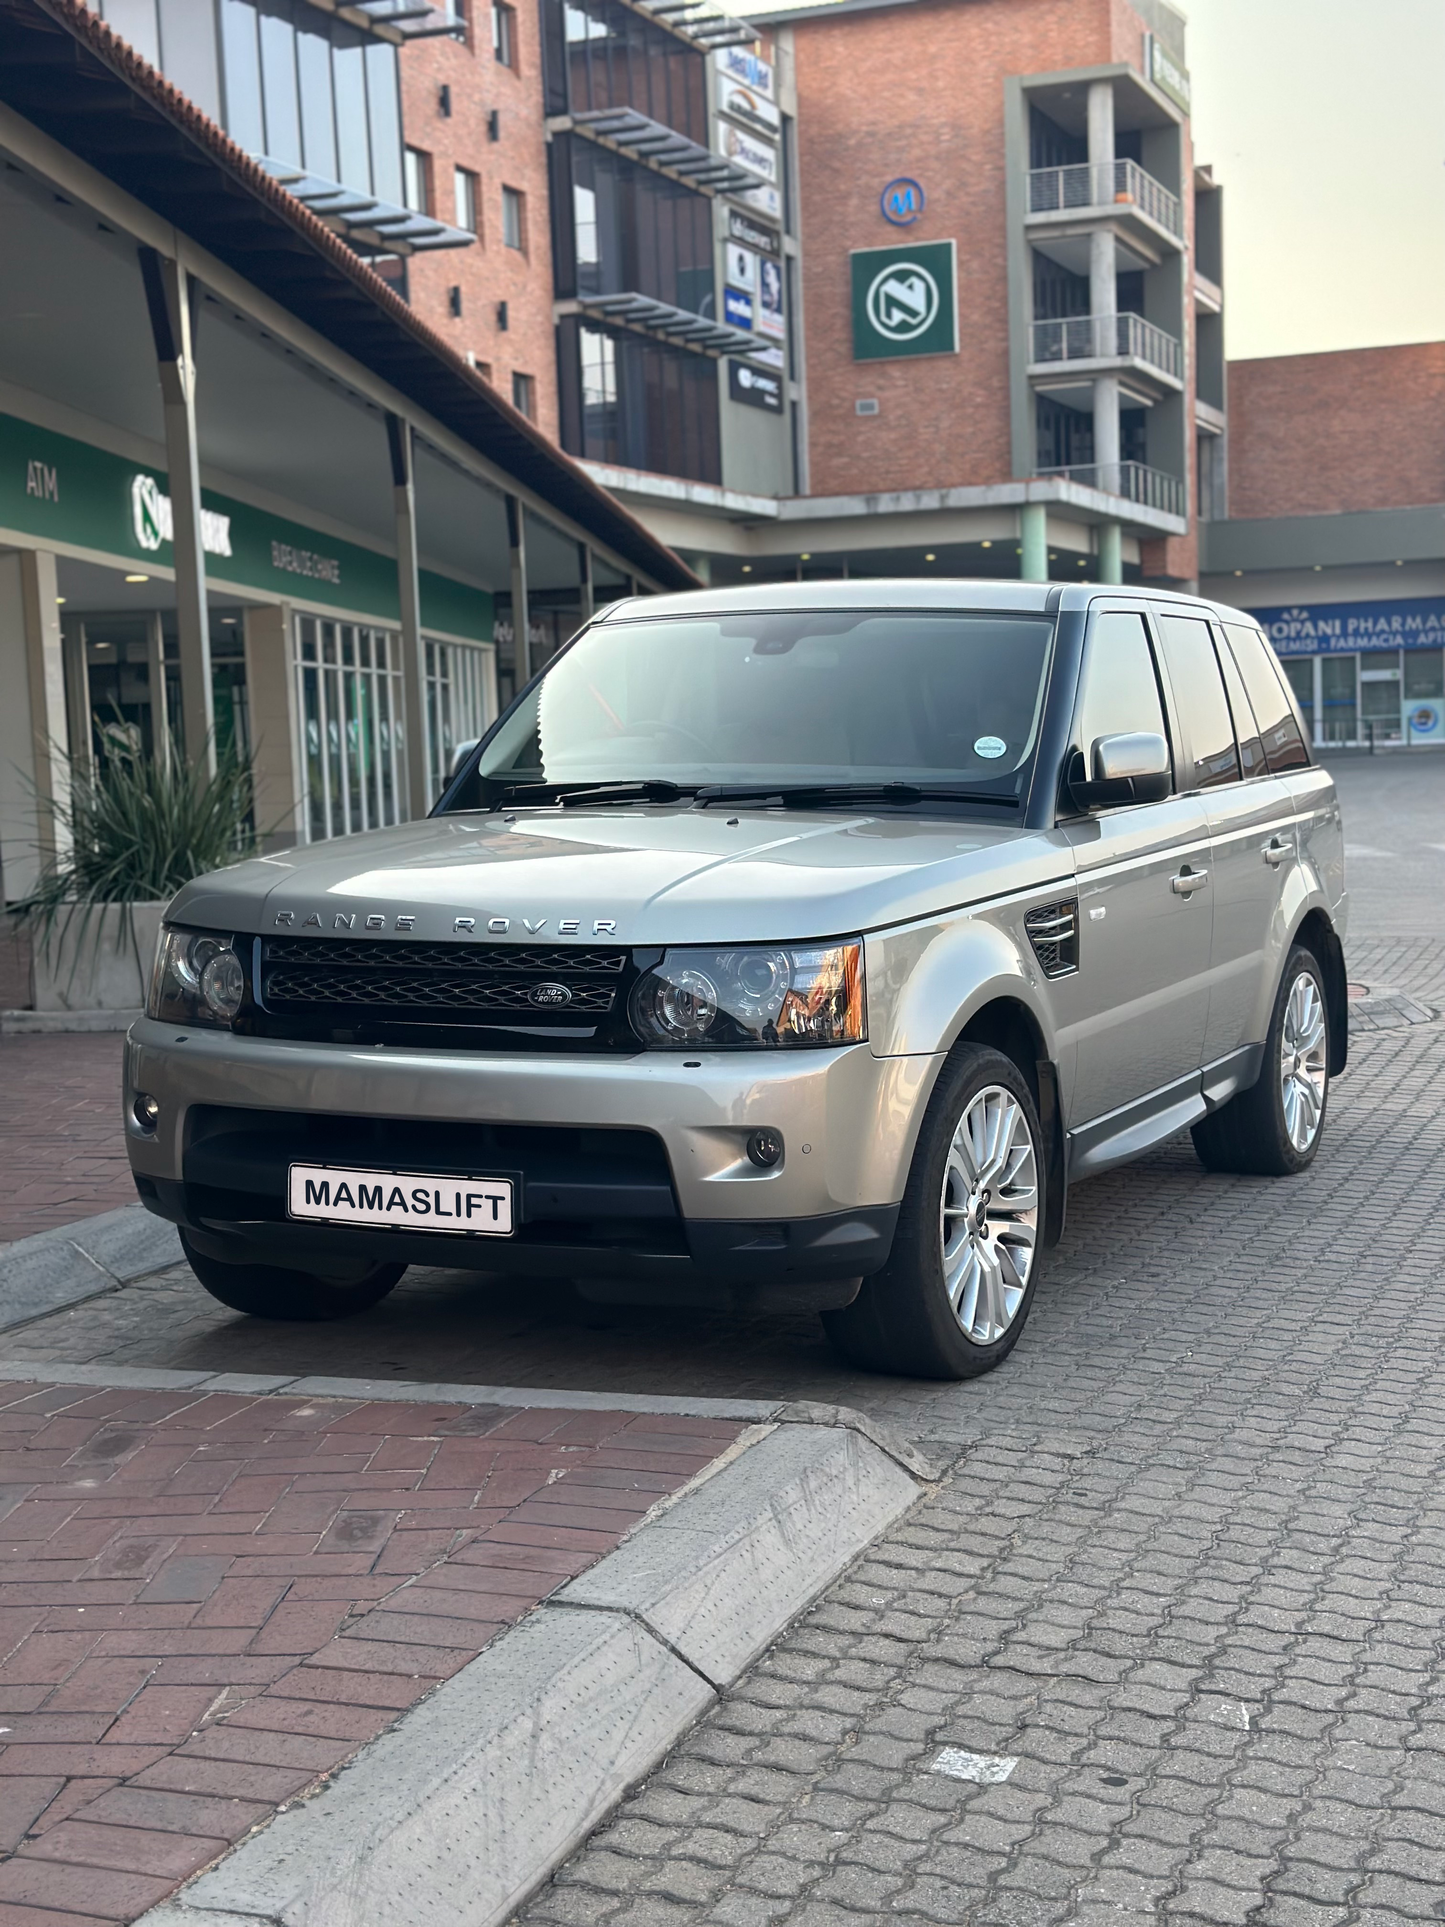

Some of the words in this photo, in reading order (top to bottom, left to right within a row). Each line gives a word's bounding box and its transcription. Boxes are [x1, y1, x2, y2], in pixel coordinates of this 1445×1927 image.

[27, 459, 59, 502] ATM
[1272, 638, 1318, 653] HEMISI
[1330, 631, 1404, 650] FARMACIA
[274, 910, 416, 932] RANGE
[452, 916, 617, 936] ROVER
[305, 1179, 506, 1221] MAMASLIFT
